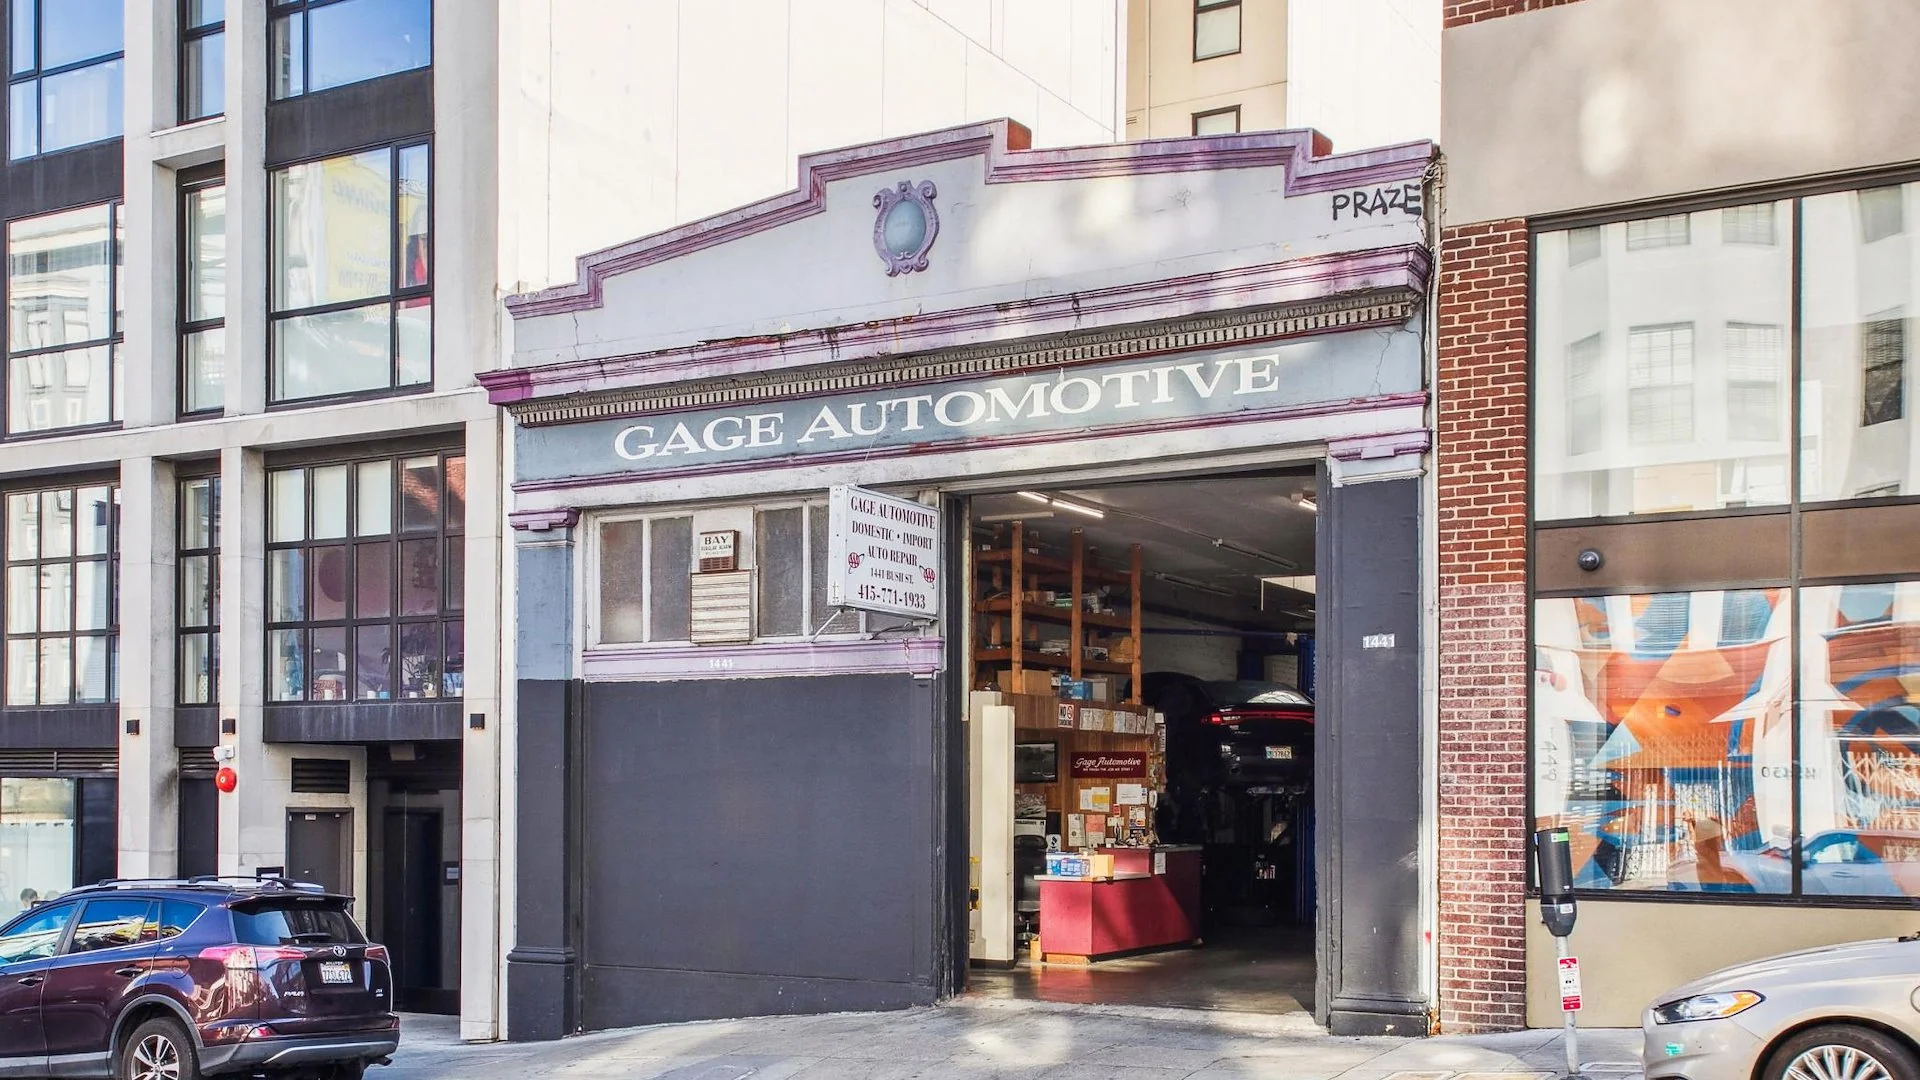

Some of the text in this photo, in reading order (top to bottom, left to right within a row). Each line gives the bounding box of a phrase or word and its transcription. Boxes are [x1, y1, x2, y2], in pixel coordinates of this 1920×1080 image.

[1332, 184, 1422, 221] PRAZE
[614, 354, 1280, 461] GAGE AUTOMOTIVE
[851, 495, 936, 530] GAGE AUTOMOTIVE
[704, 536, 728, 545] BAY
[852, 520, 934, 550] DOMESTIC IMPORT
[868, 545, 918, 567] AUTO REPAIR
[871, 567, 885, 579] 1441
[886, 570, 903, 582] BUSH
[858, 583, 926, 610] 415-771-1933
[1362, 633, 1395, 648] 1441
[709, 659, 732, 669] 1441
[1060, 705, 1067, 718] NO
[1074, 756, 1142, 769] Gage Automotive
